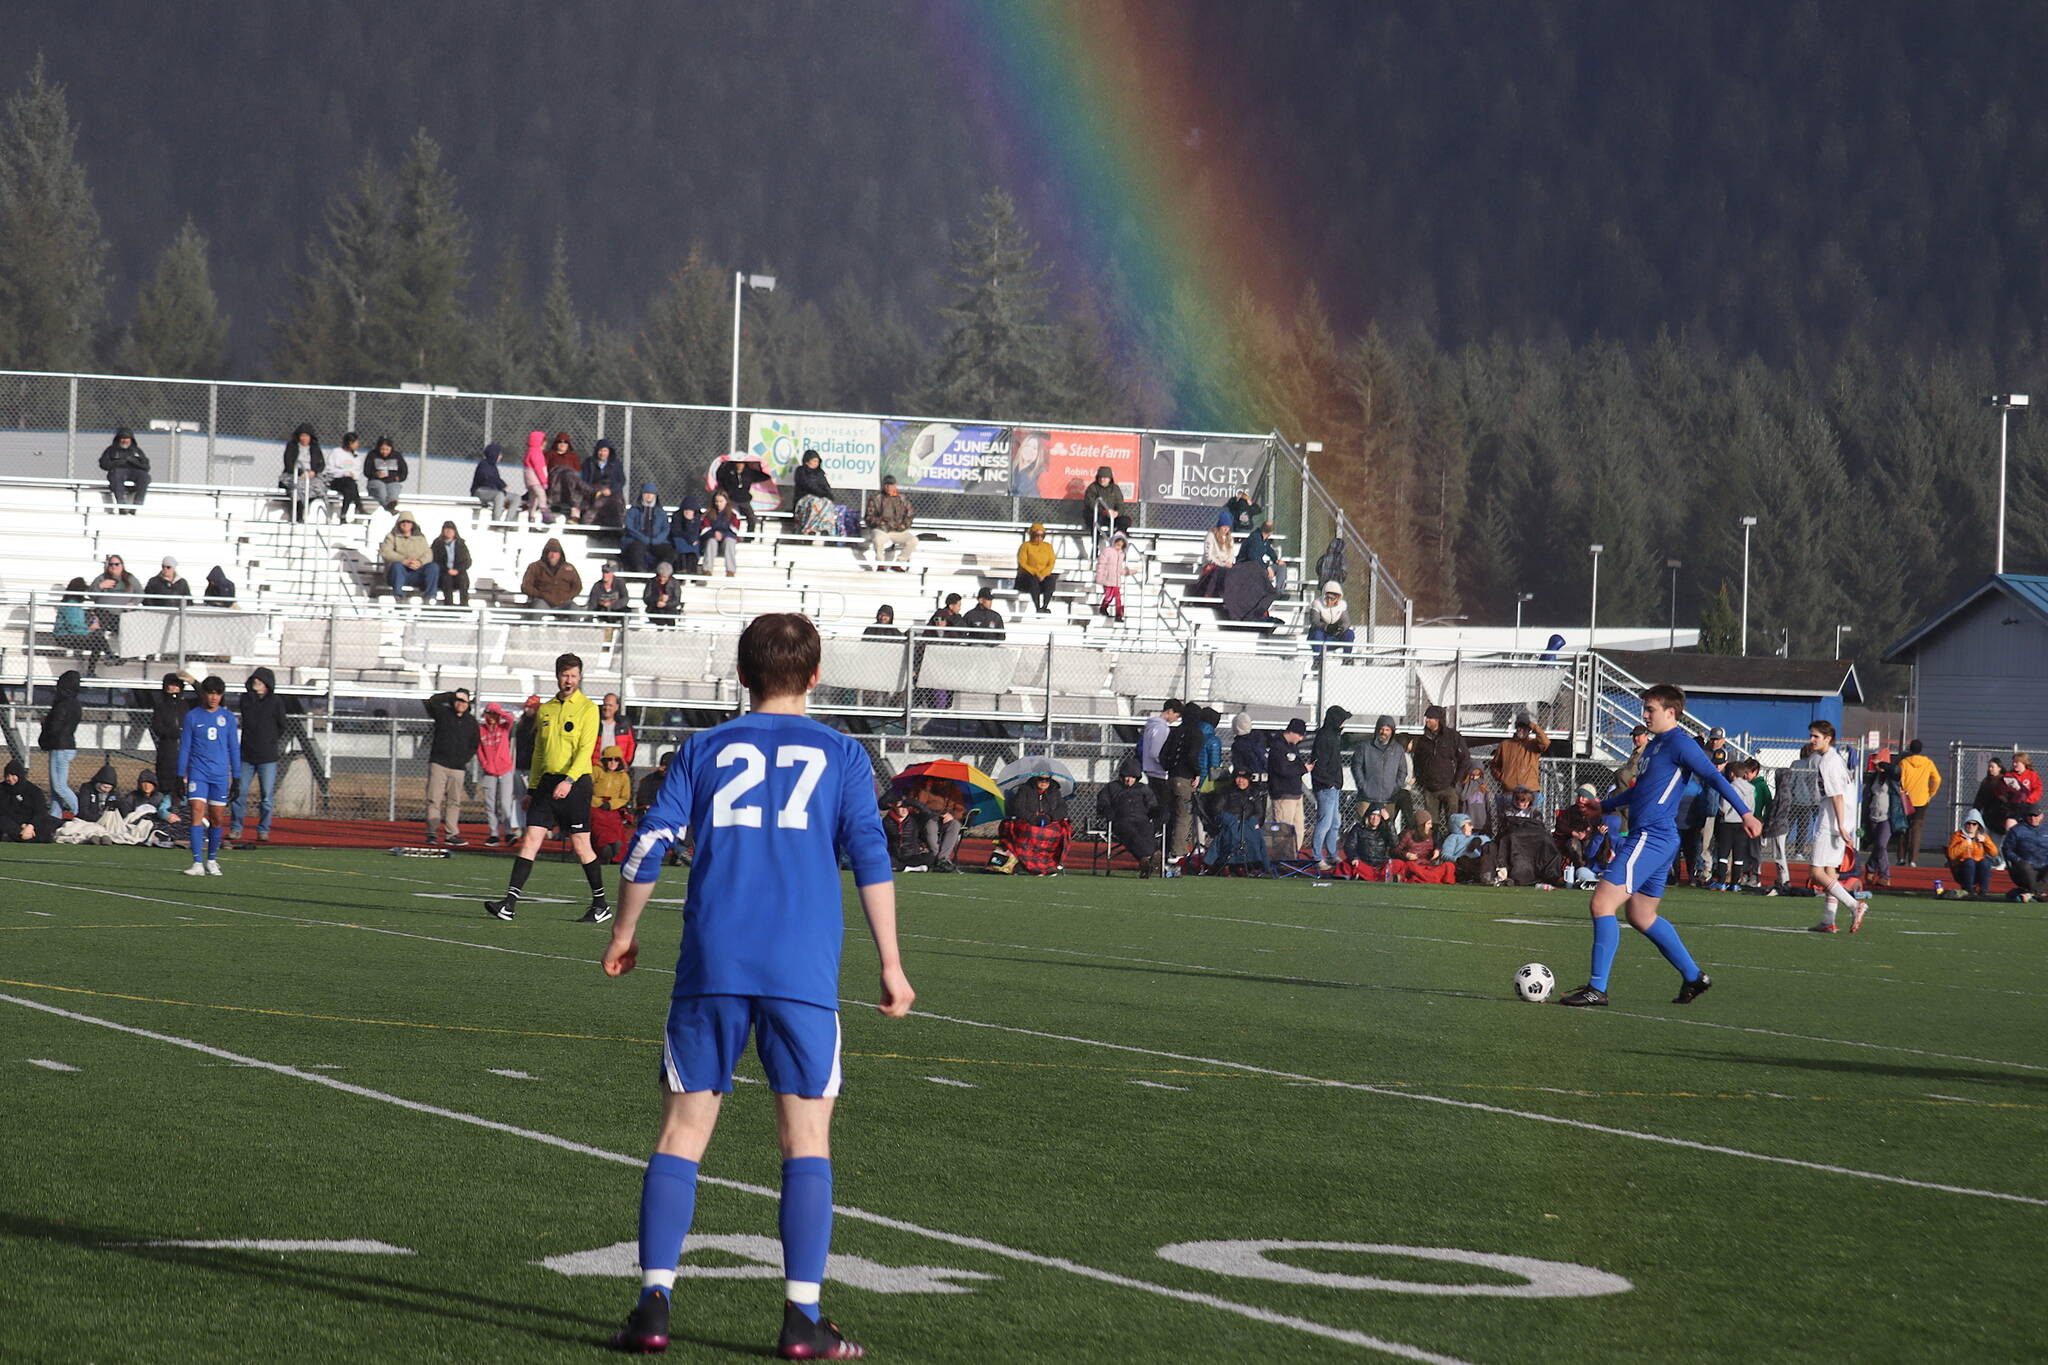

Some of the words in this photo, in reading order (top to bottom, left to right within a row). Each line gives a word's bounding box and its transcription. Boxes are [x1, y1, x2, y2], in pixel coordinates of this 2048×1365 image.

[803, 437, 875, 454] Radiation
[953, 440, 1009, 454] JUNEAU
[1069, 442, 1099, 458] State
[1100, 444, 1131, 459] Farm
[821, 455, 875, 474] cology
[942, 453, 1009, 468] BUSINESS
[984, 470, 1009, 482] INC
[207, 727, 218, 741] 8
[713, 742, 827, 830] 27
